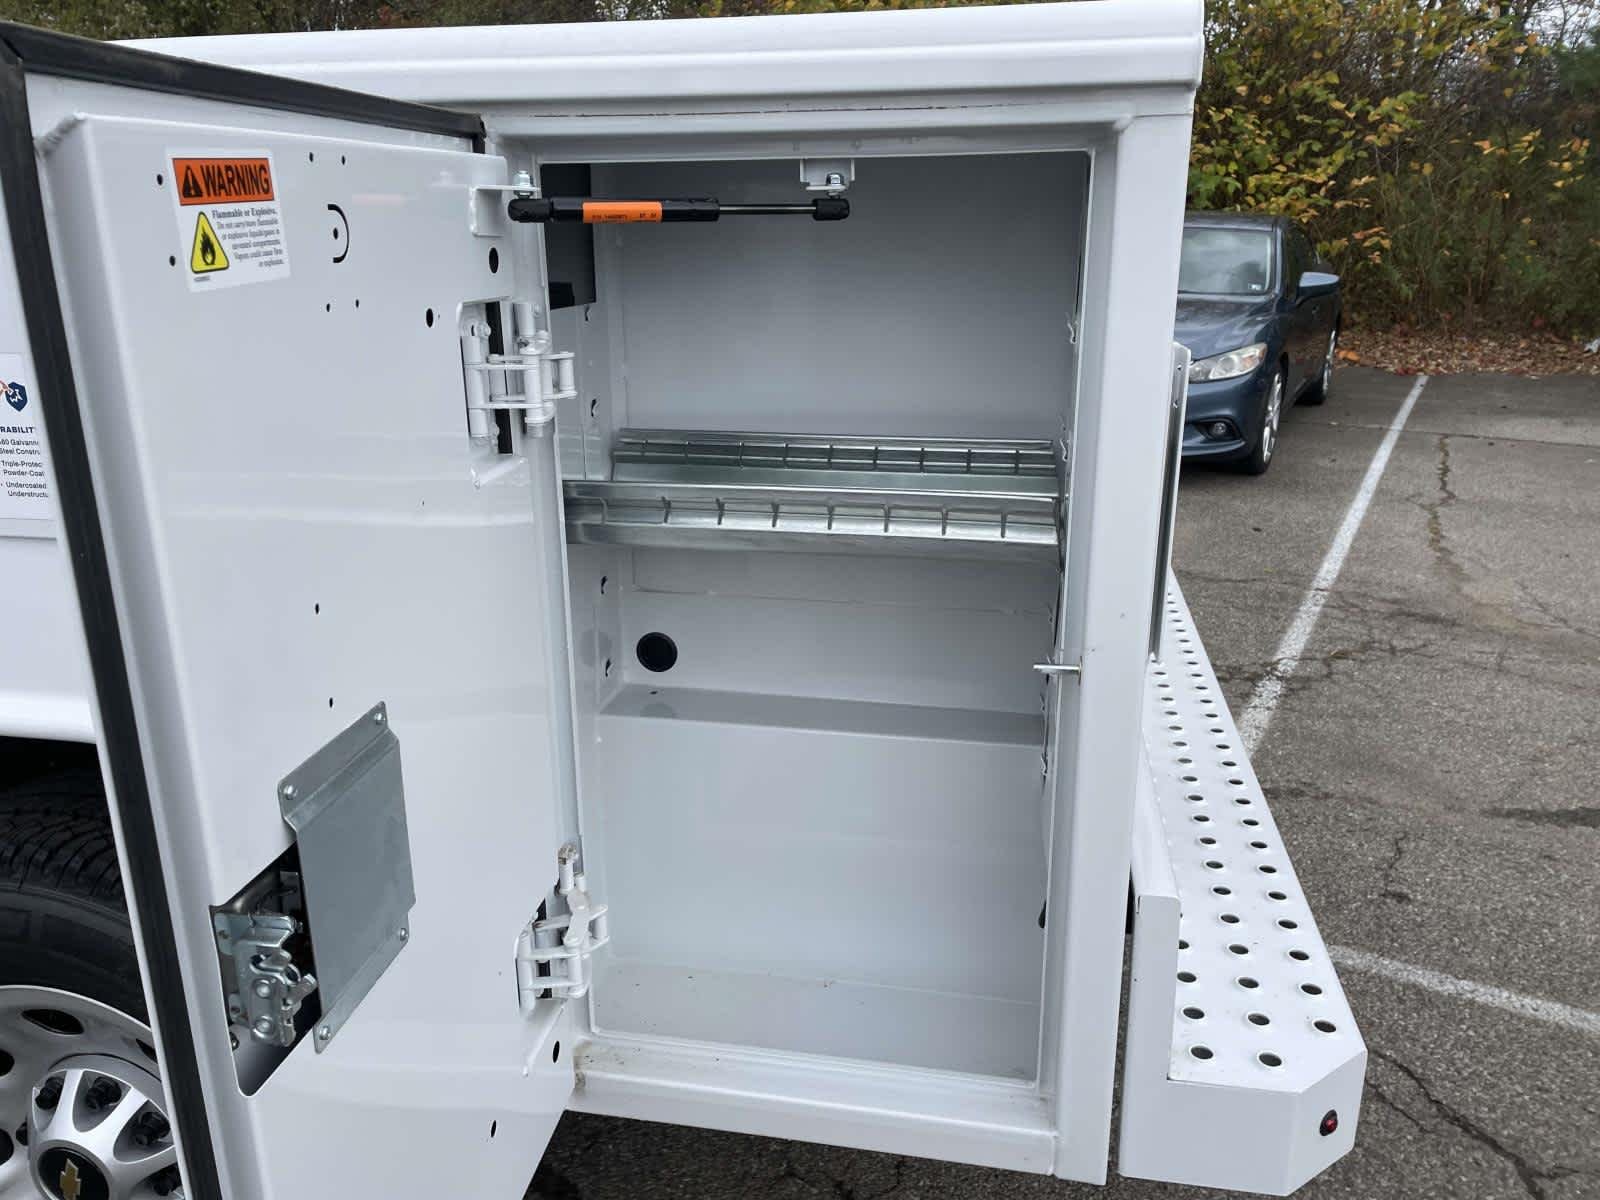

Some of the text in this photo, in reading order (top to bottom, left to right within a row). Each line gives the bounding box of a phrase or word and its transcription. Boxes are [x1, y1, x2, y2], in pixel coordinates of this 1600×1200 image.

[200, 163, 270, 197] WARNING
[212, 208, 243, 219] Flammable
[244, 209, 250, 217] or
[0, 426, 35, 434] RABILIT
[0, 438, 10, 446] 60
